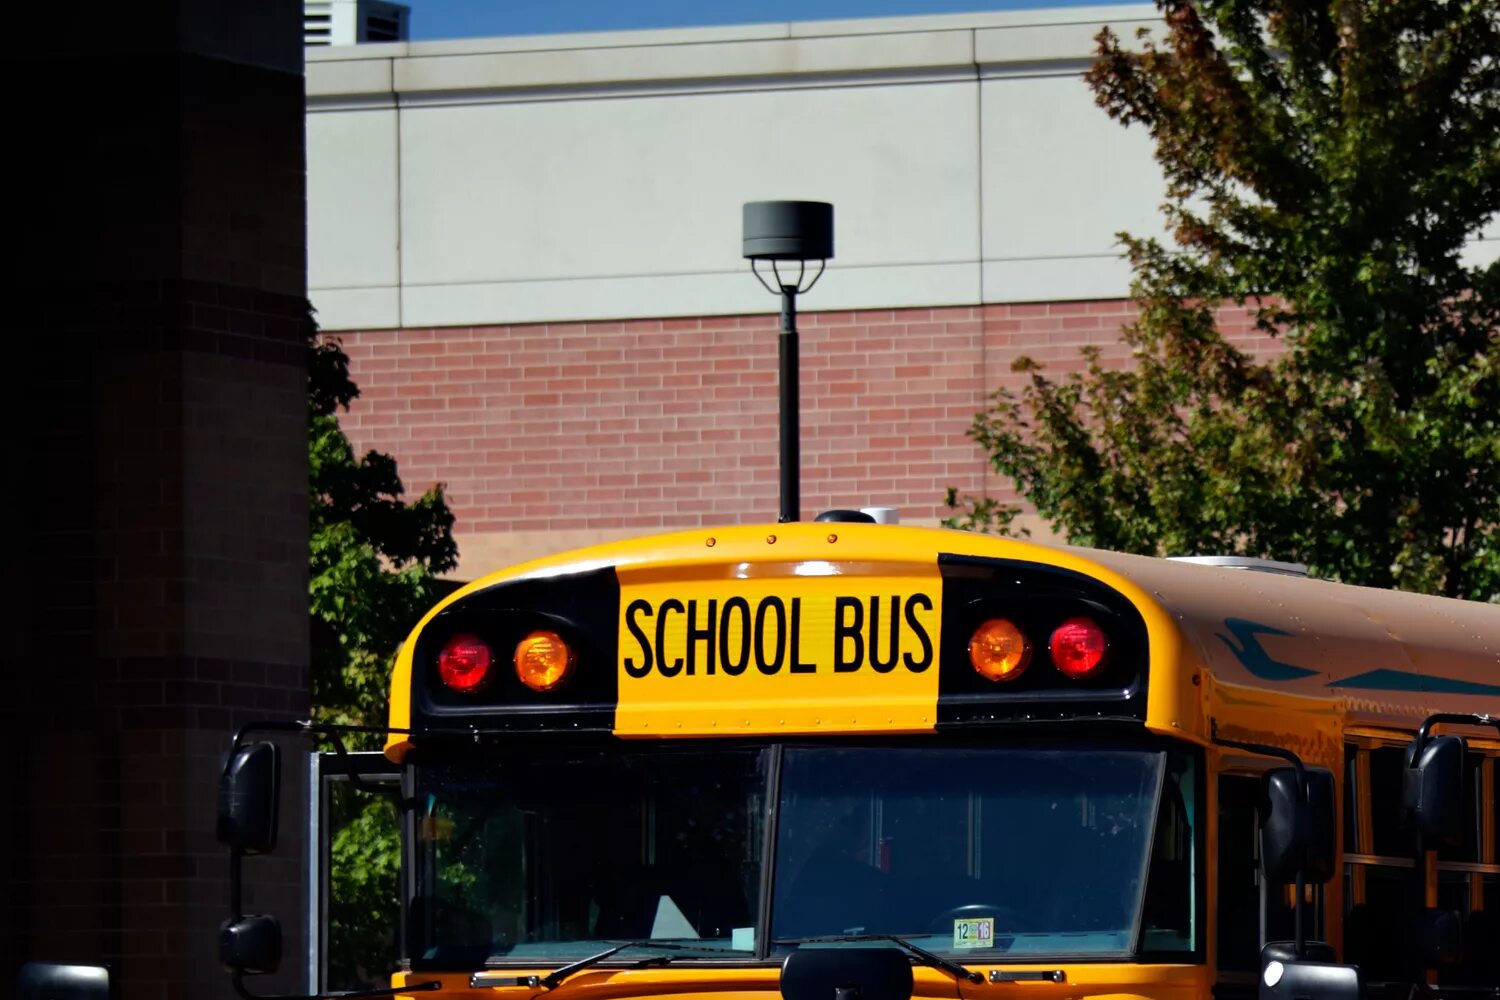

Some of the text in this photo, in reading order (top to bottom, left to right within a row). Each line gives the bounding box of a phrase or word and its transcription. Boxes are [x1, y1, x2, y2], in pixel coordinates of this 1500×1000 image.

[624, 591, 934, 678] SCHOOL BUS
[957, 923, 969, 940] 12
